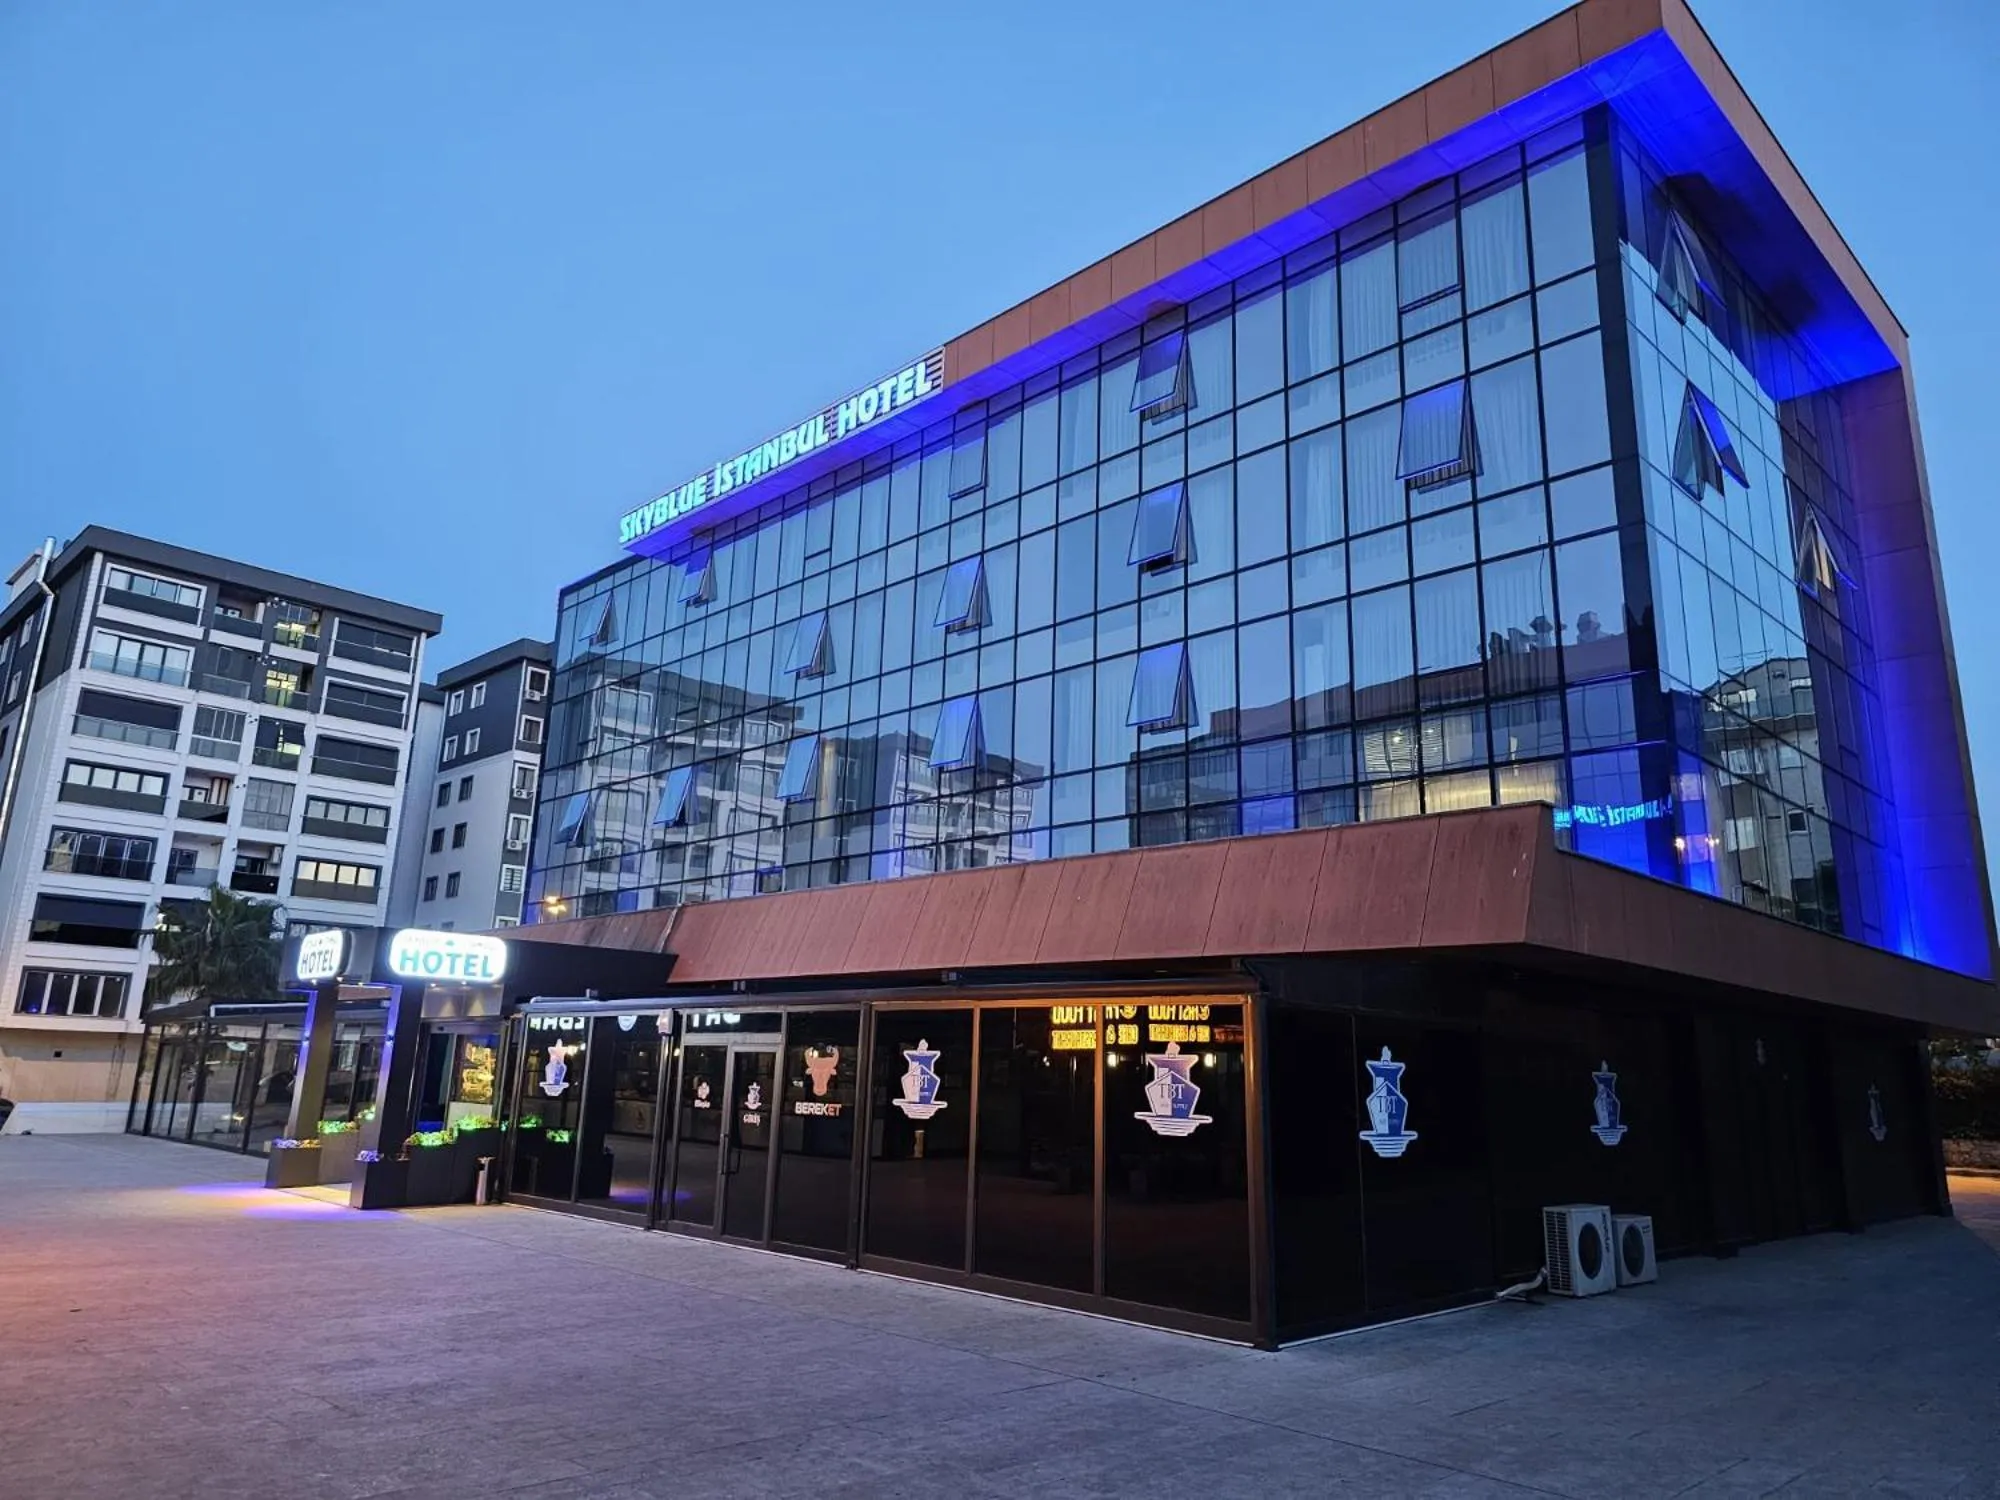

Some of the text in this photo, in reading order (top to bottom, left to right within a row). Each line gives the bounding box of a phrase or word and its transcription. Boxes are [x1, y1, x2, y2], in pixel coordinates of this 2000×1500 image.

[619, 361, 933, 543] SKYBLUE İSTANBUL HOTEL
[300, 948, 334, 976] HOTEL
[399, 947, 495, 979] HOTEL
[1158, 1083, 1185, 1099] TBT
[794, 1101, 842, 1117] BEREKET
